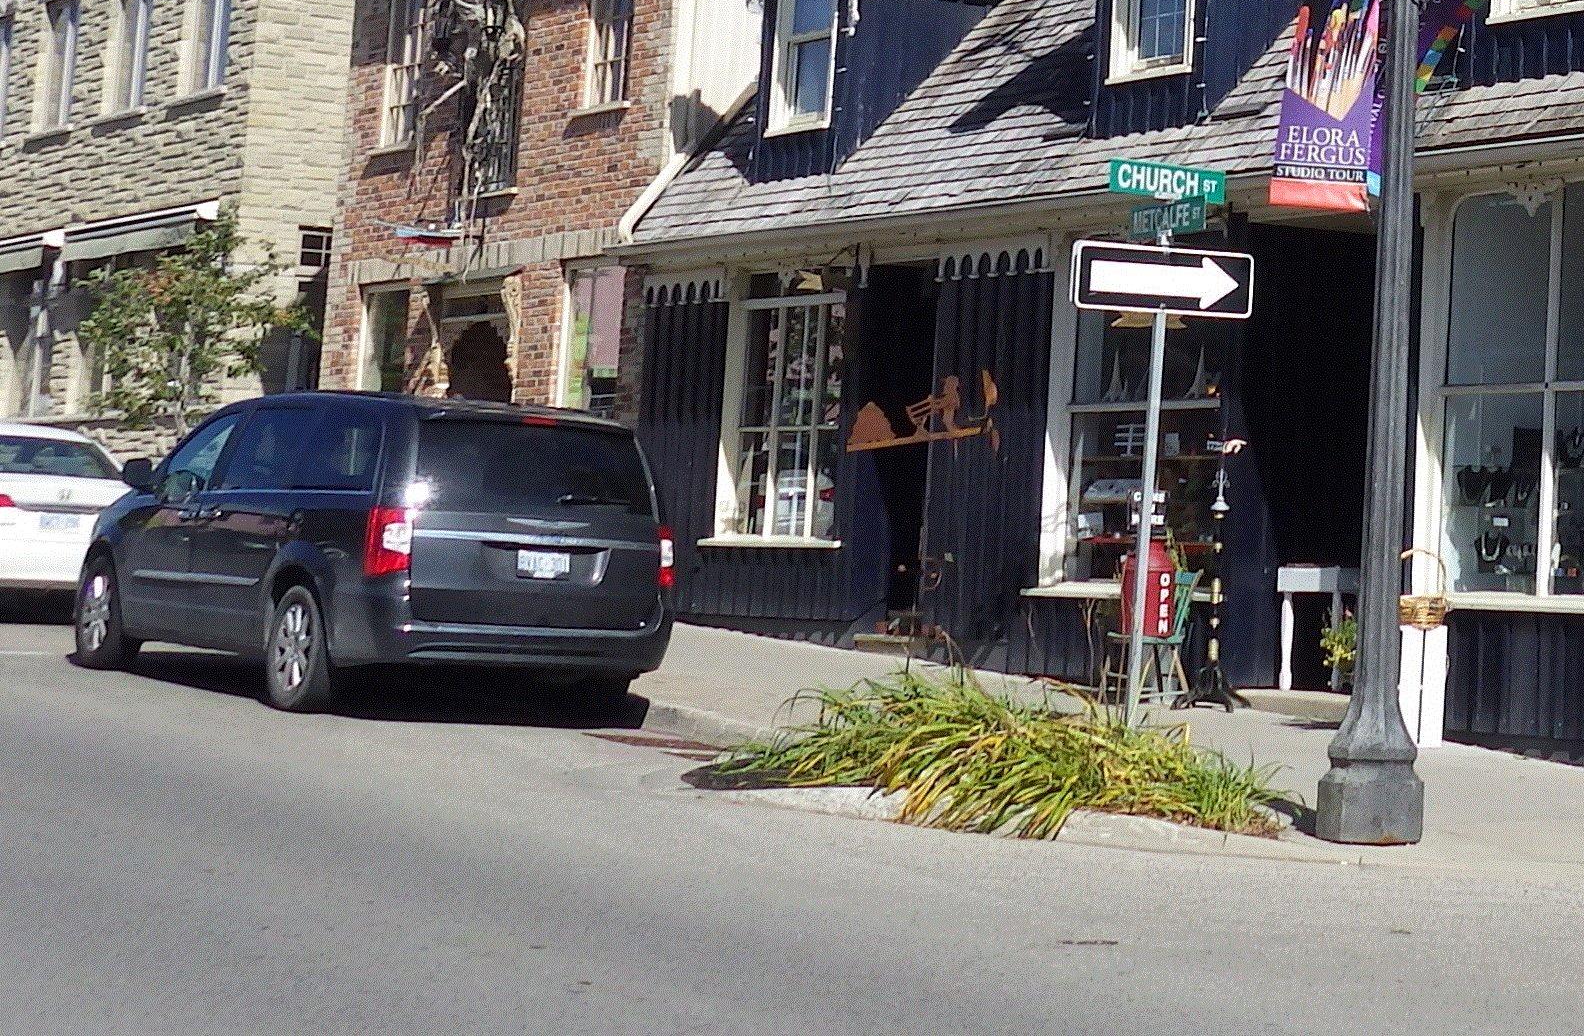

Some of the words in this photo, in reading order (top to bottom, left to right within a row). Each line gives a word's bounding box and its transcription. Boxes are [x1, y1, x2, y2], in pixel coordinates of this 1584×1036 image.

[1288, 125, 1361, 148] ELORA
[1280, 142, 1366, 165] FERGUS
[1117, 163, 1200, 197] CHURCH
[1203, 178, 1218, 194] ST
[1276, 165, 1326, 180] STUDIO
[1327, 169, 1365, 182] TOUR
[1132, 202, 1191, 235] METCALFE
[1192, 206, 1201, 220] ST
[1157, 572, 1171, 634] OPEN
